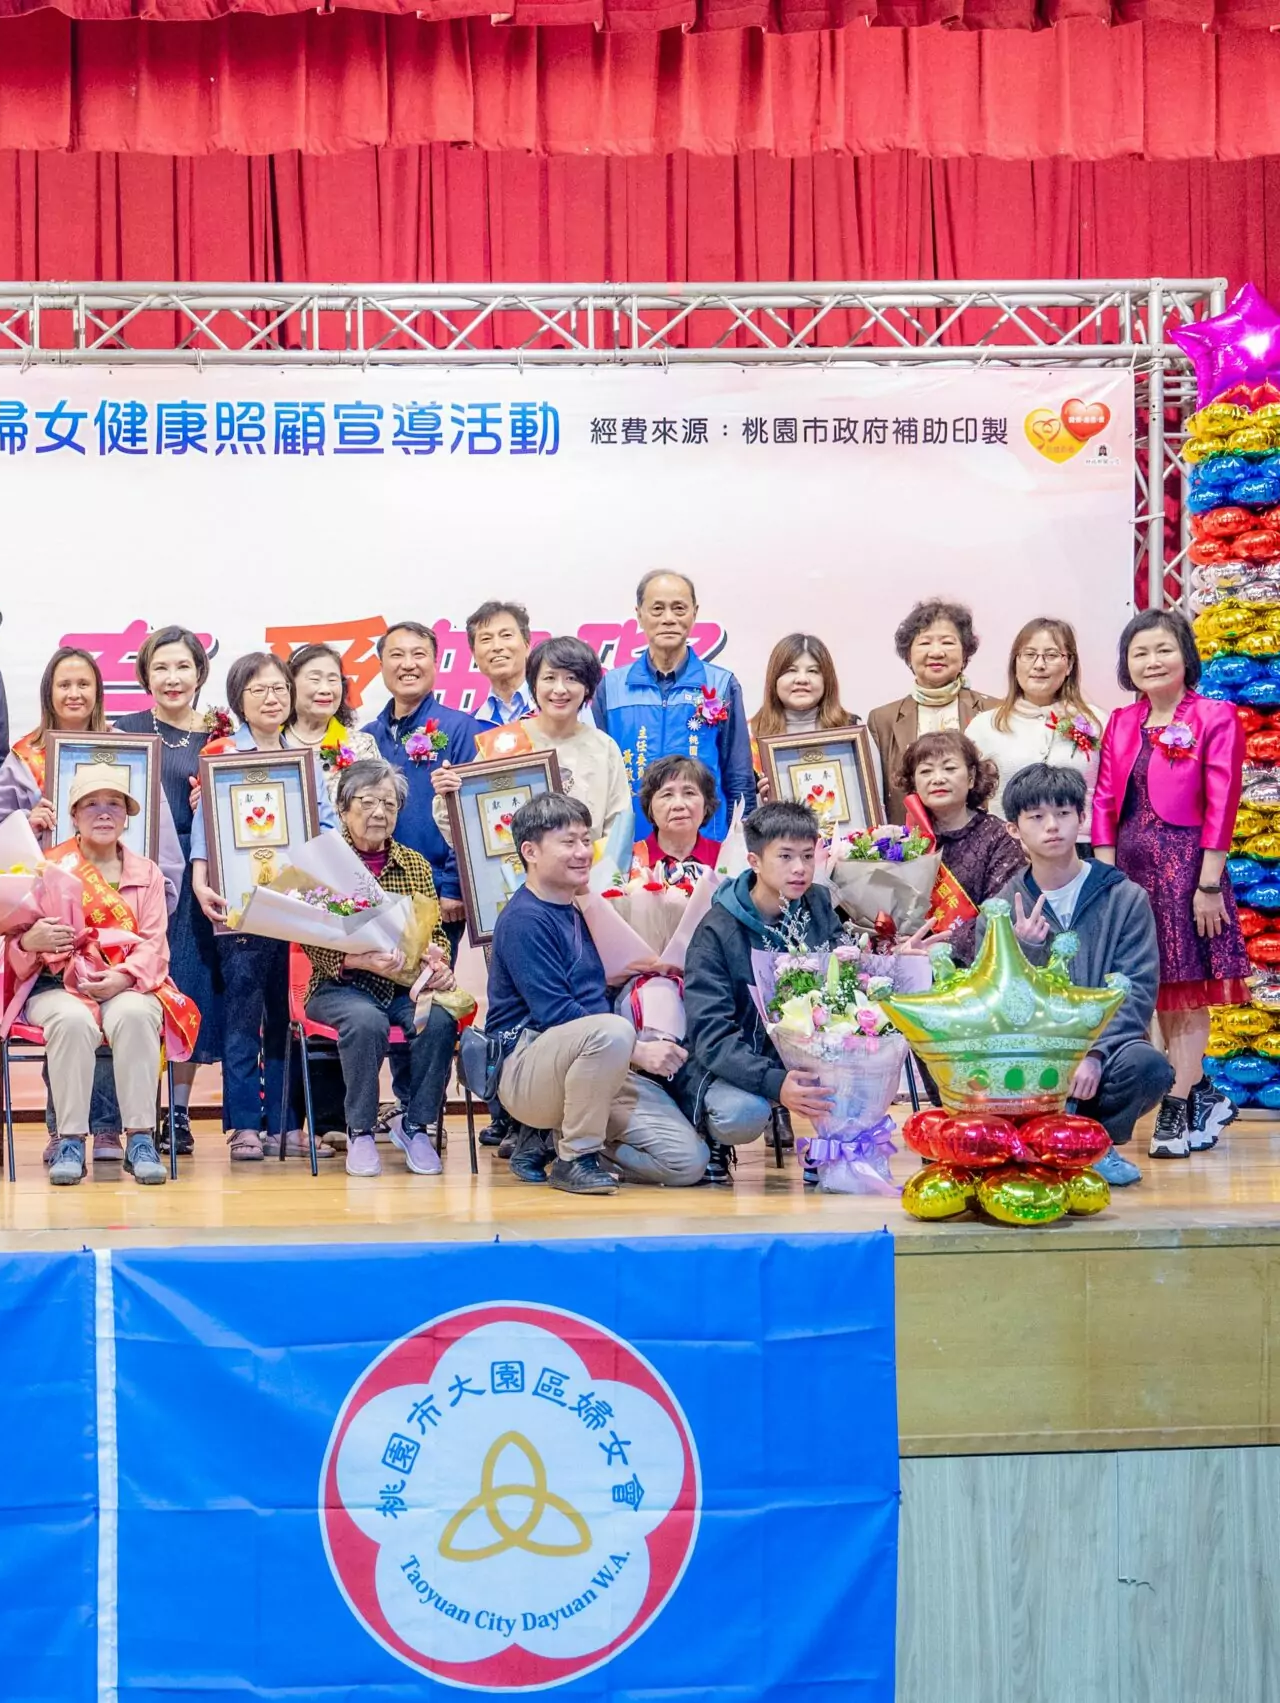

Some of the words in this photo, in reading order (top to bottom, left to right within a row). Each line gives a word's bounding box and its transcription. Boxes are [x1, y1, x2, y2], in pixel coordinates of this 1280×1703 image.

[375, 1360, 645, 1519] 桃園市大園區婦女會
[400, 1555, 471, 1624] Taoyuan
[474, 1610, 517, 1637] City
[521, 1588, 598, 1631] Dayuan
[591, 1551, 631, 1589] W.A.
